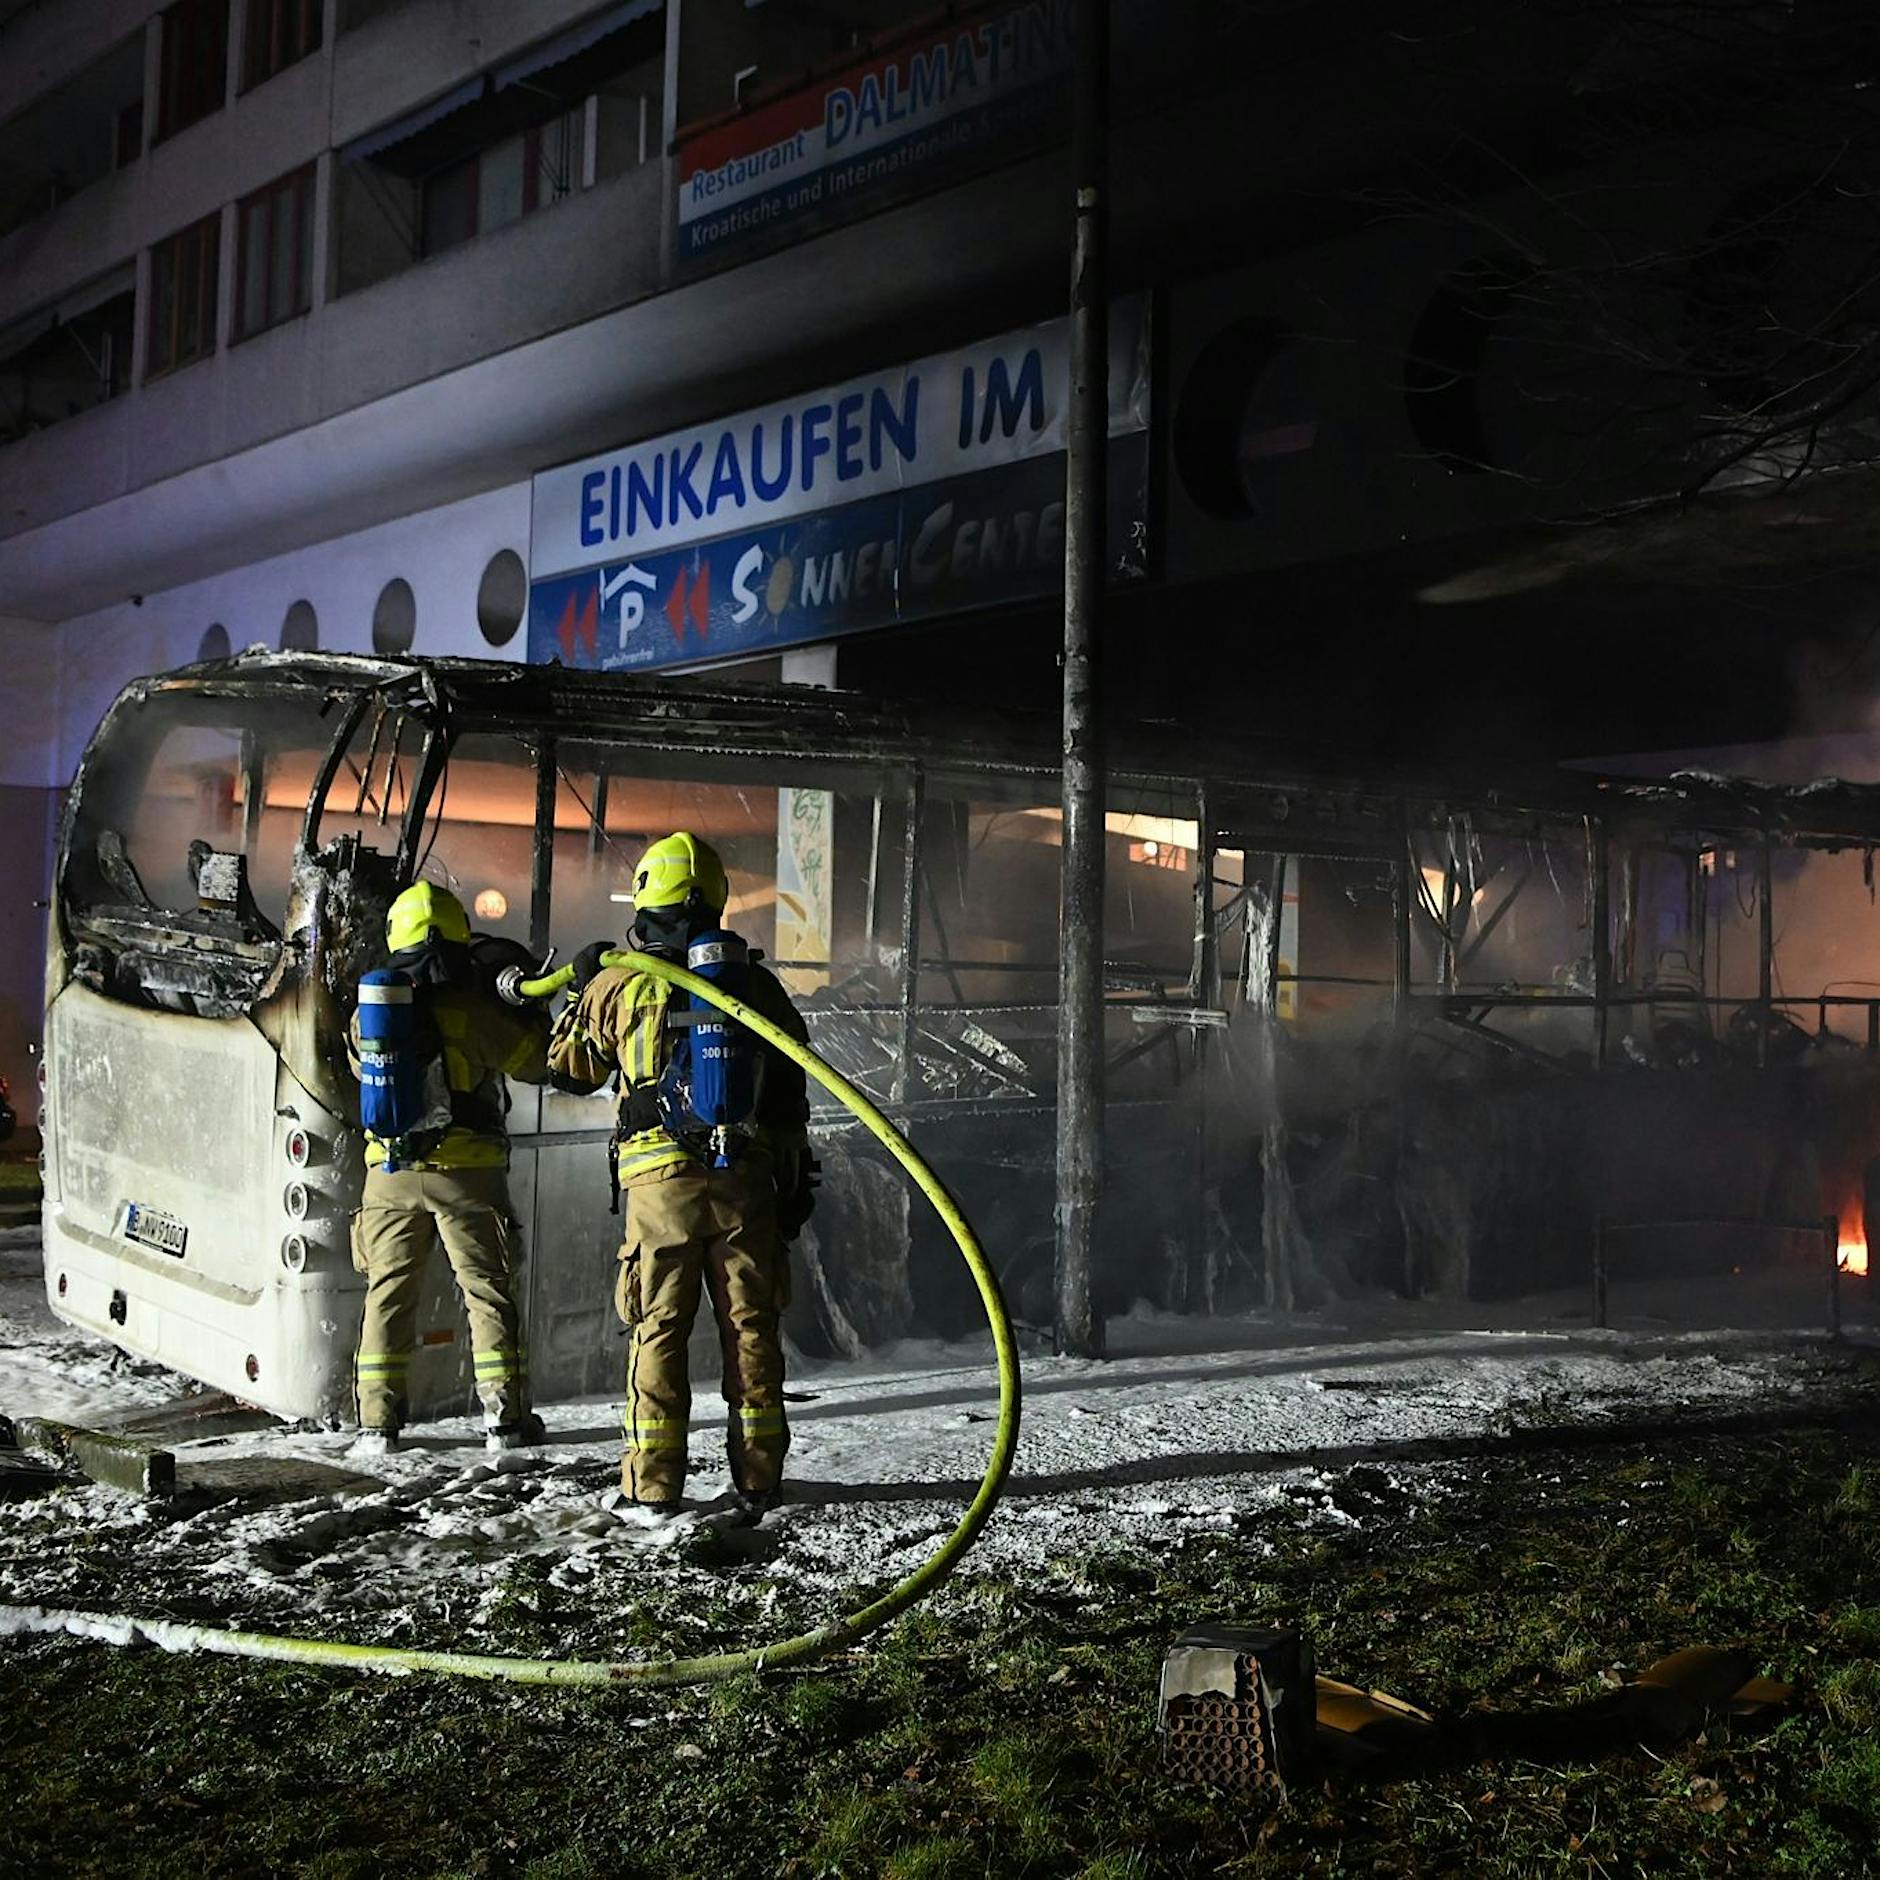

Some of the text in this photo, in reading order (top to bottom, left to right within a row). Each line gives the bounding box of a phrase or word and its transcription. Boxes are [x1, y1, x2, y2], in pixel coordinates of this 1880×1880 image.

[690, 122, 971, 249] Kroatische und Internationale
[691, 128, 806, 204] Restaurant
[579, 348, 1045, 547] EINKAUFEN IM
[618, 590, 645, 650] P
[701, 1046, 722, 1060] 300
